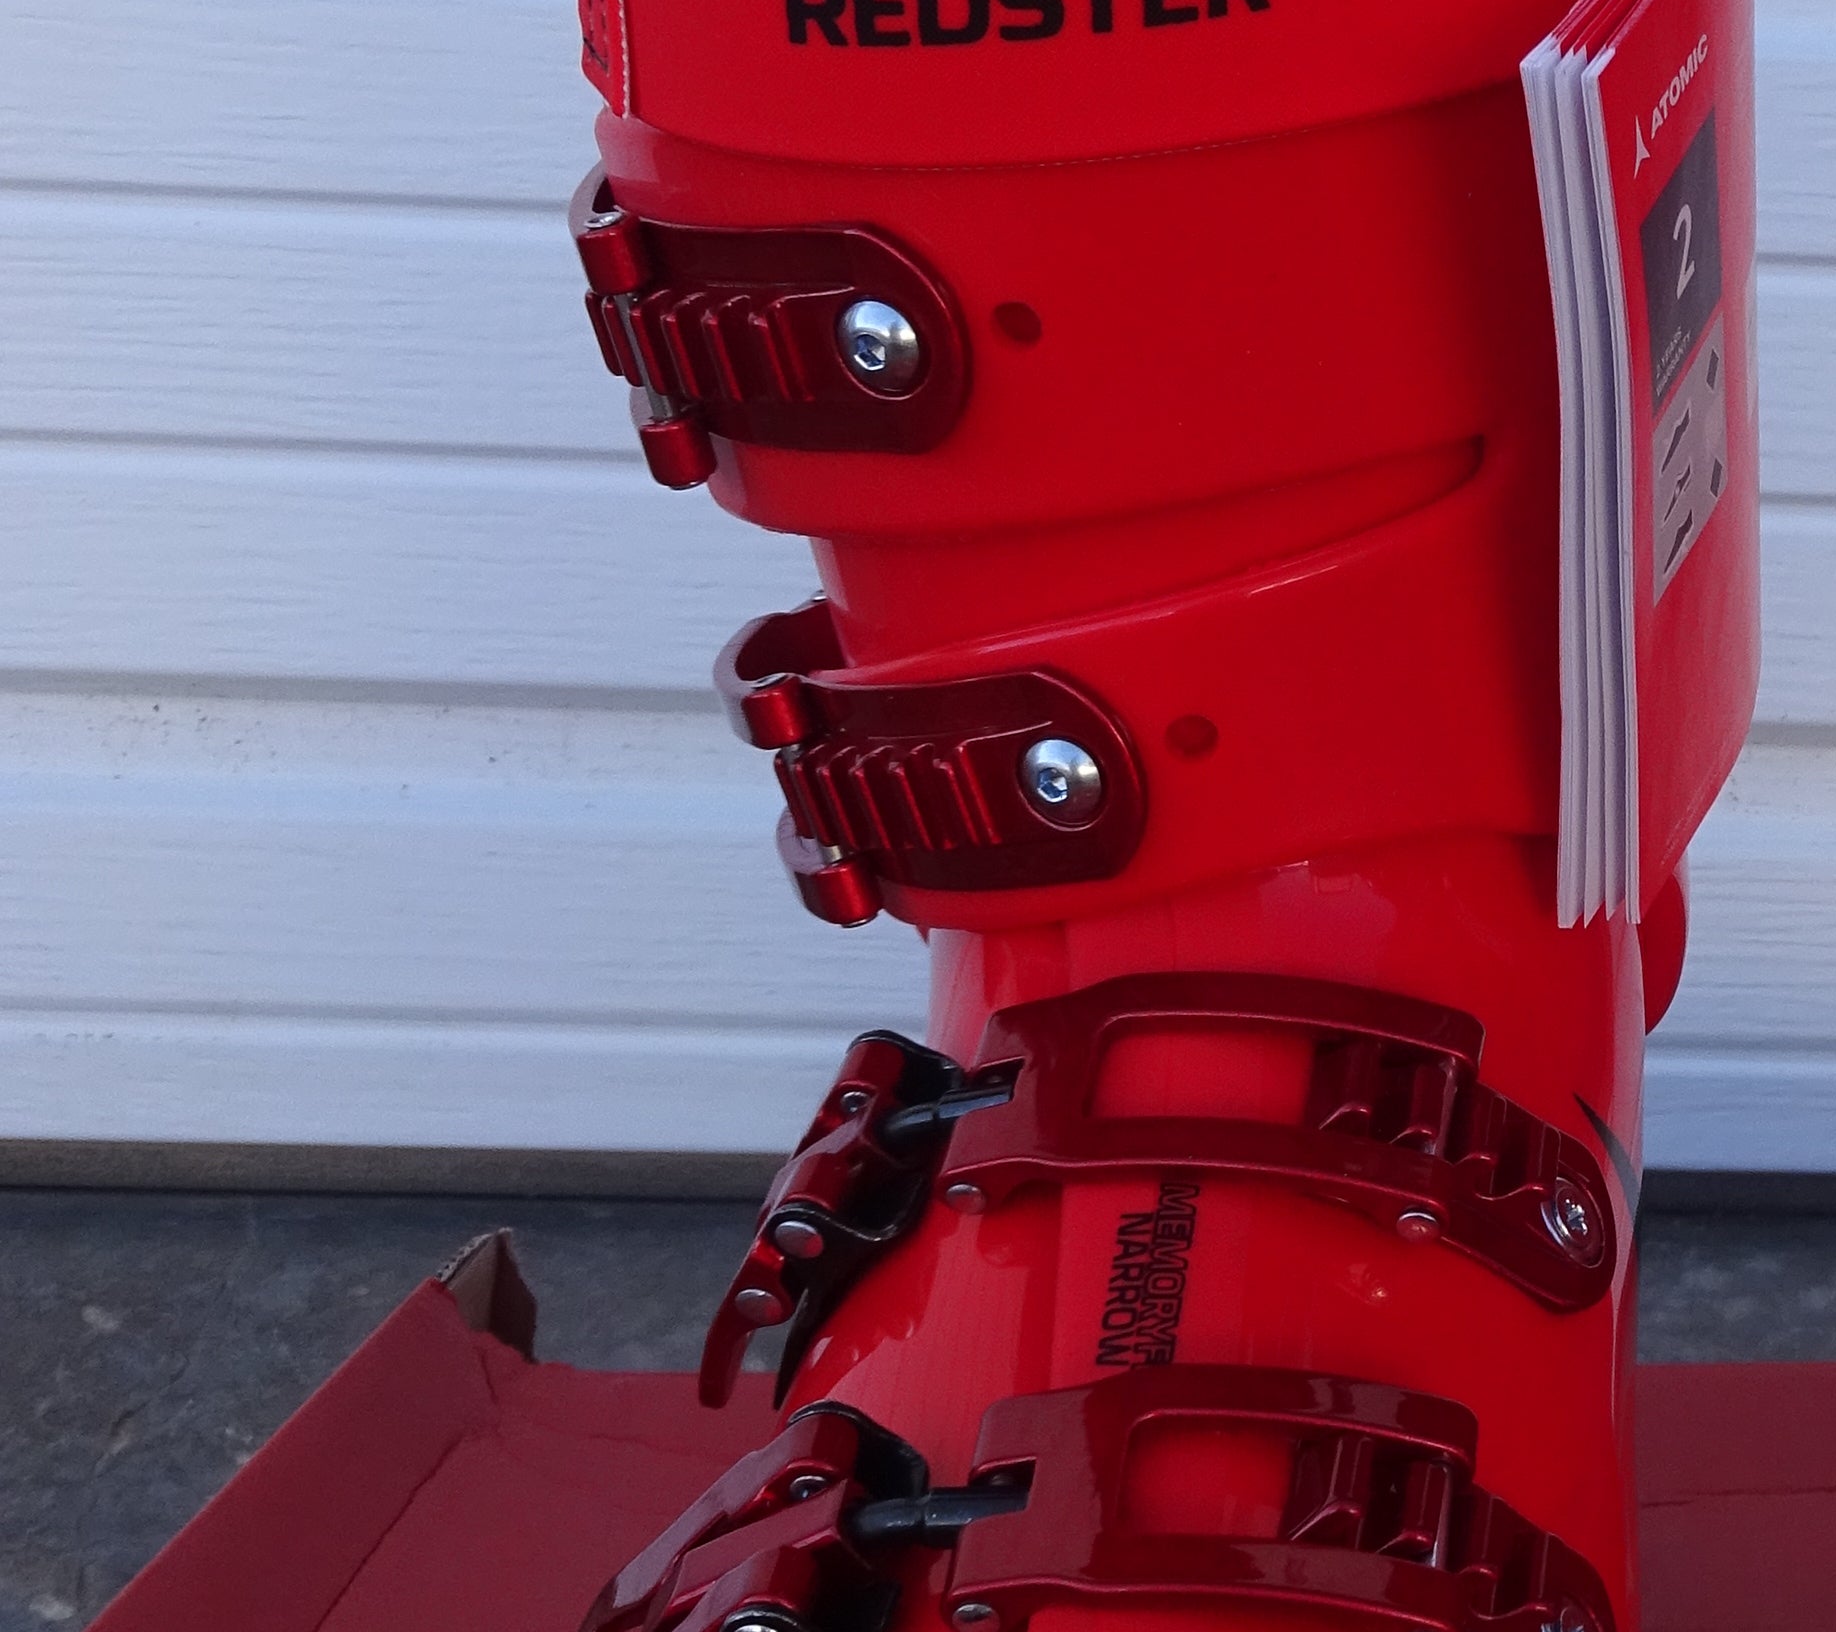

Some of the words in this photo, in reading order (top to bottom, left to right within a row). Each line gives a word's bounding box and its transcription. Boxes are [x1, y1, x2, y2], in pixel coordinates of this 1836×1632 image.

[1651, 34, 1708, 139] ATOMIC
[1673, 204, 1695, 300] 2
[1096, 1212, 1156, 1366] NARROW
[1131, 1182, 1200, 1369] MEMORYF
